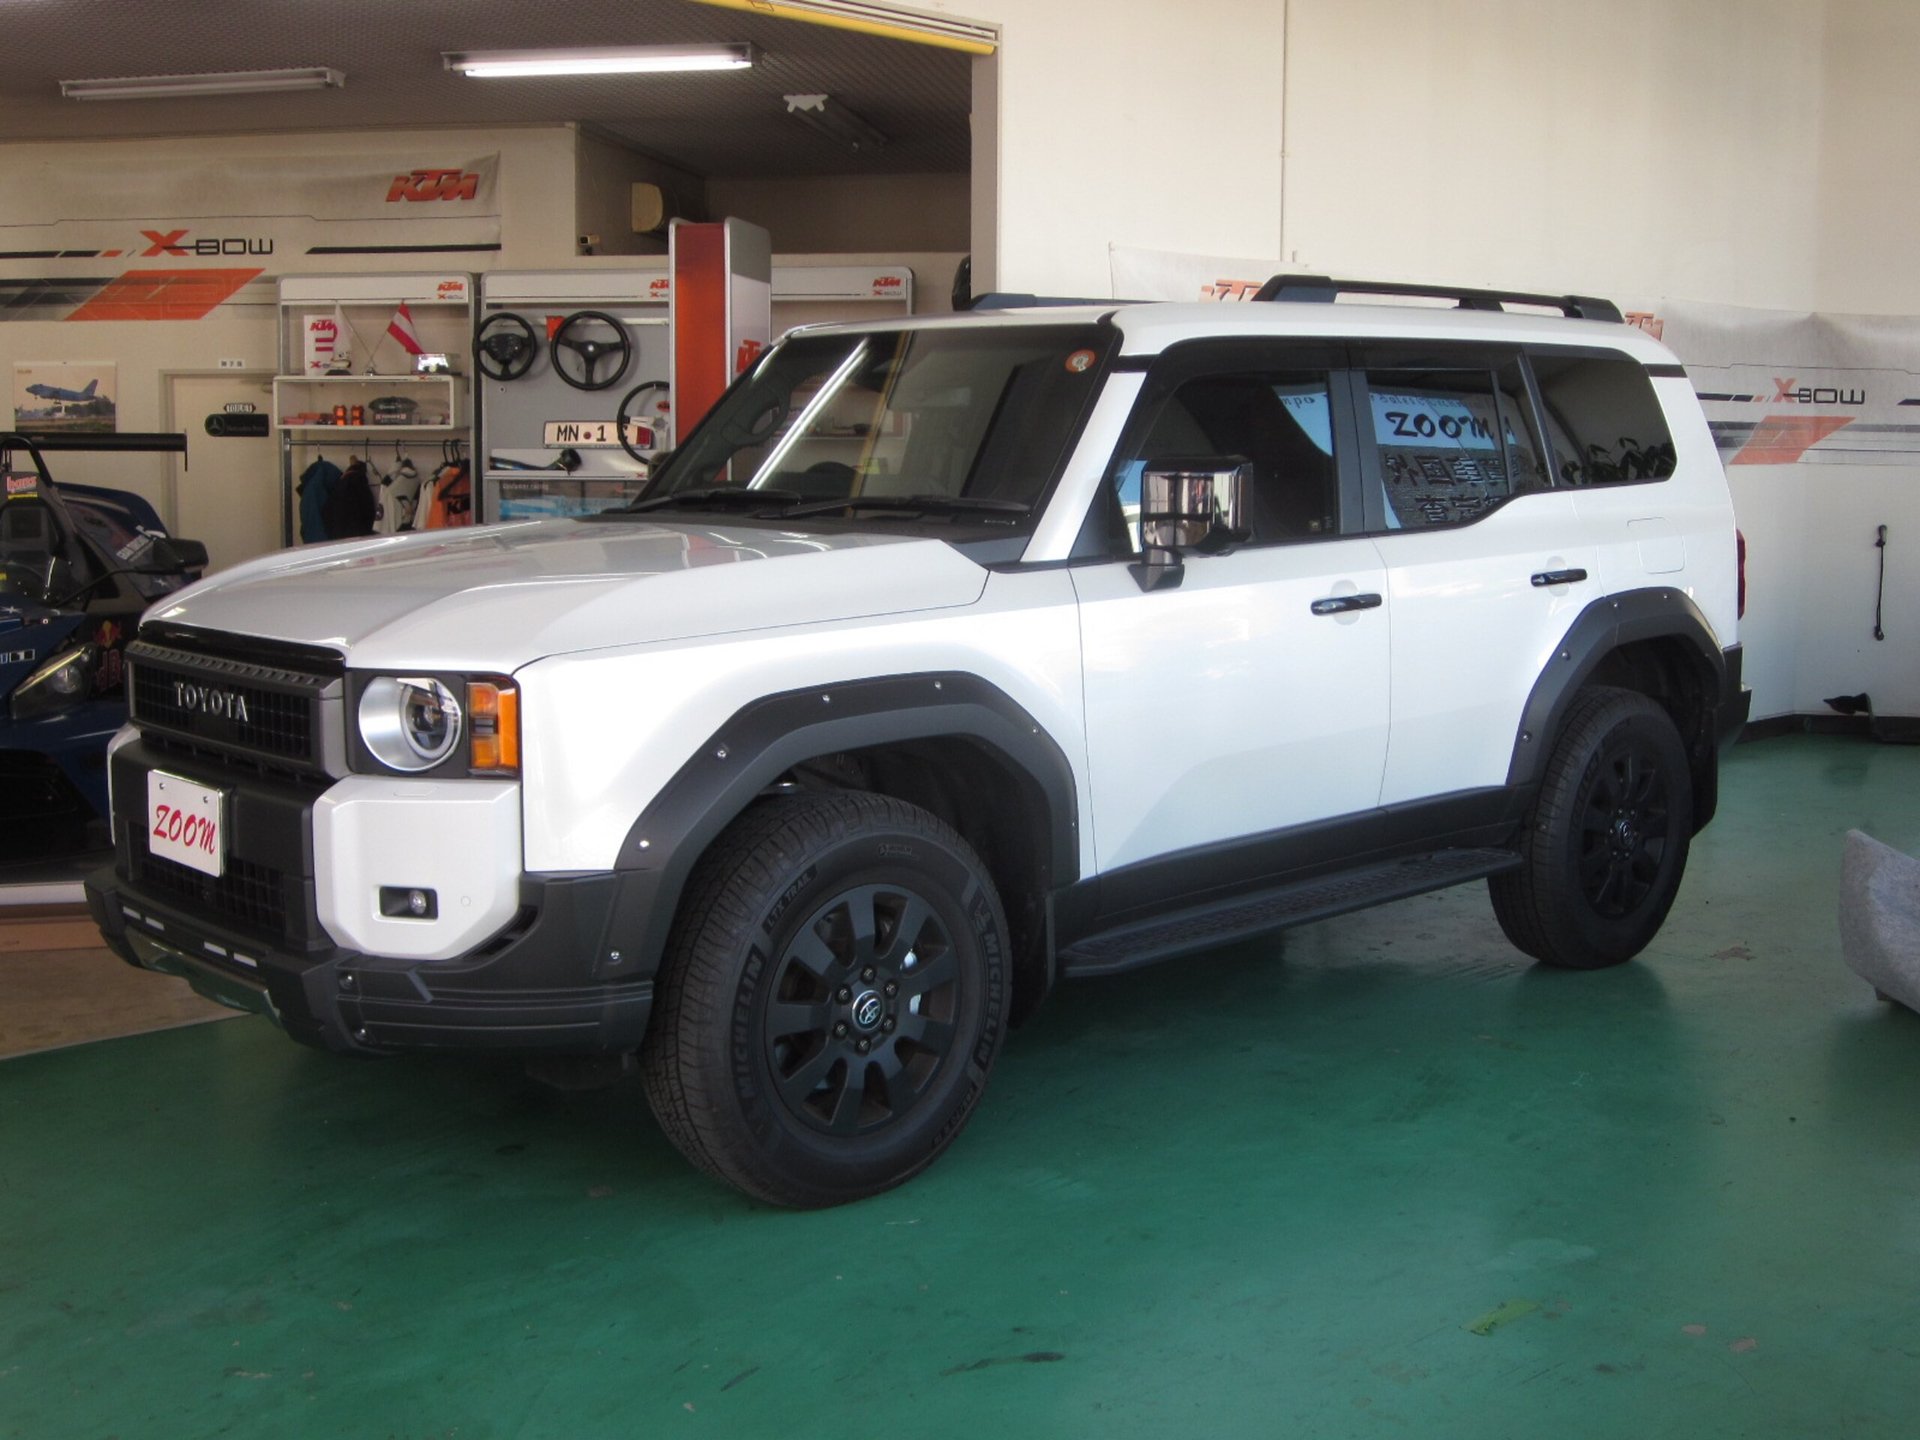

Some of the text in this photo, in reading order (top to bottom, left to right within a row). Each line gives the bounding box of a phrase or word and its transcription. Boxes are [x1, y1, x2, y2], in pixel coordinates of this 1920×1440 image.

[385, 168, 481, 203] KTM
[139, 229, 274, 257] X-BOW
[436, 281, 464, 291] KTM
[872, 276, 902, 288] KTM
[556, 424, 580, 442] MN
[595, 424, 607, 442] 1
[174, 681, 249, 723] TOYOTA
[153, 804, 216, 855] ZOOM
